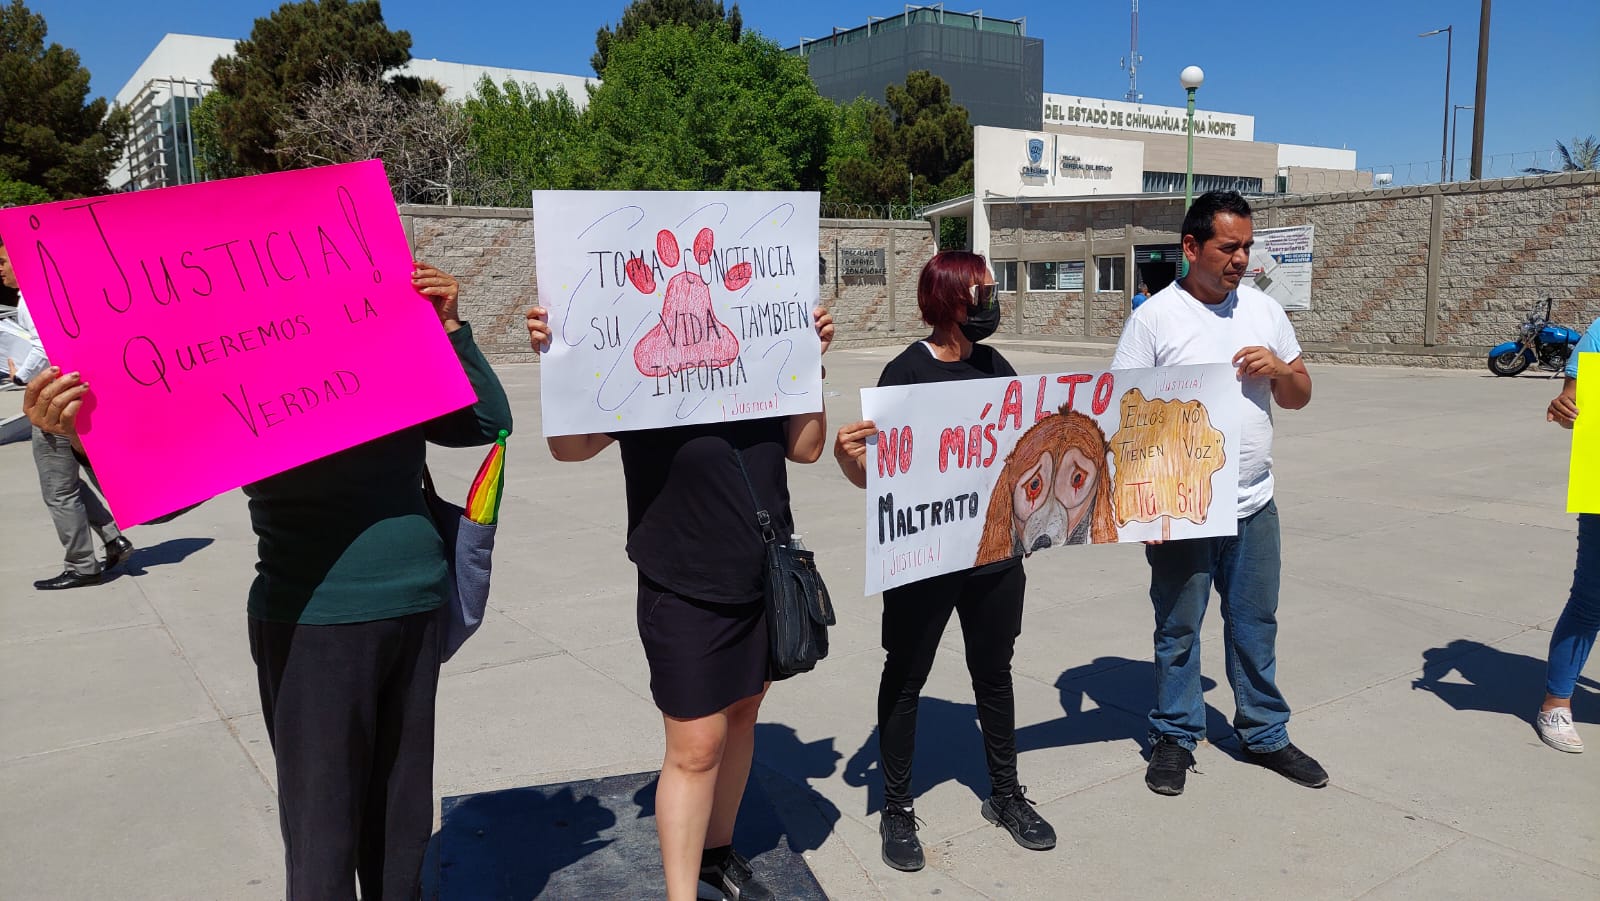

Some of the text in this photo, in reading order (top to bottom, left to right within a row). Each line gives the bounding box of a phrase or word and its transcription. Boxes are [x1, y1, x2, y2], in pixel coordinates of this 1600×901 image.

[1044, 104, 1065, 120] DEL
[1068, 105, 1108, 125] ESTADO
[1110, 110, 1124, 127] DE
[1126, 112, 1180, 132] CHIHUAHUA
[1208, 120, 1237, 137] NORTE
[587, 245, 796, 289] TOMA CONCIENCIA
[122, 297, 379, 394] QUEREMOS LA
[590, 292, 810, 351] SU VIDA TAMBIÉN
[222, 369, 361, 438] VERDAD
[651, 355, 748, 397] IMPORTA
[998, 372, 1115, 432] ALTO
[877, 402, 998, 479] NO MÁS
[1182, 408, 1201, 425] NO
